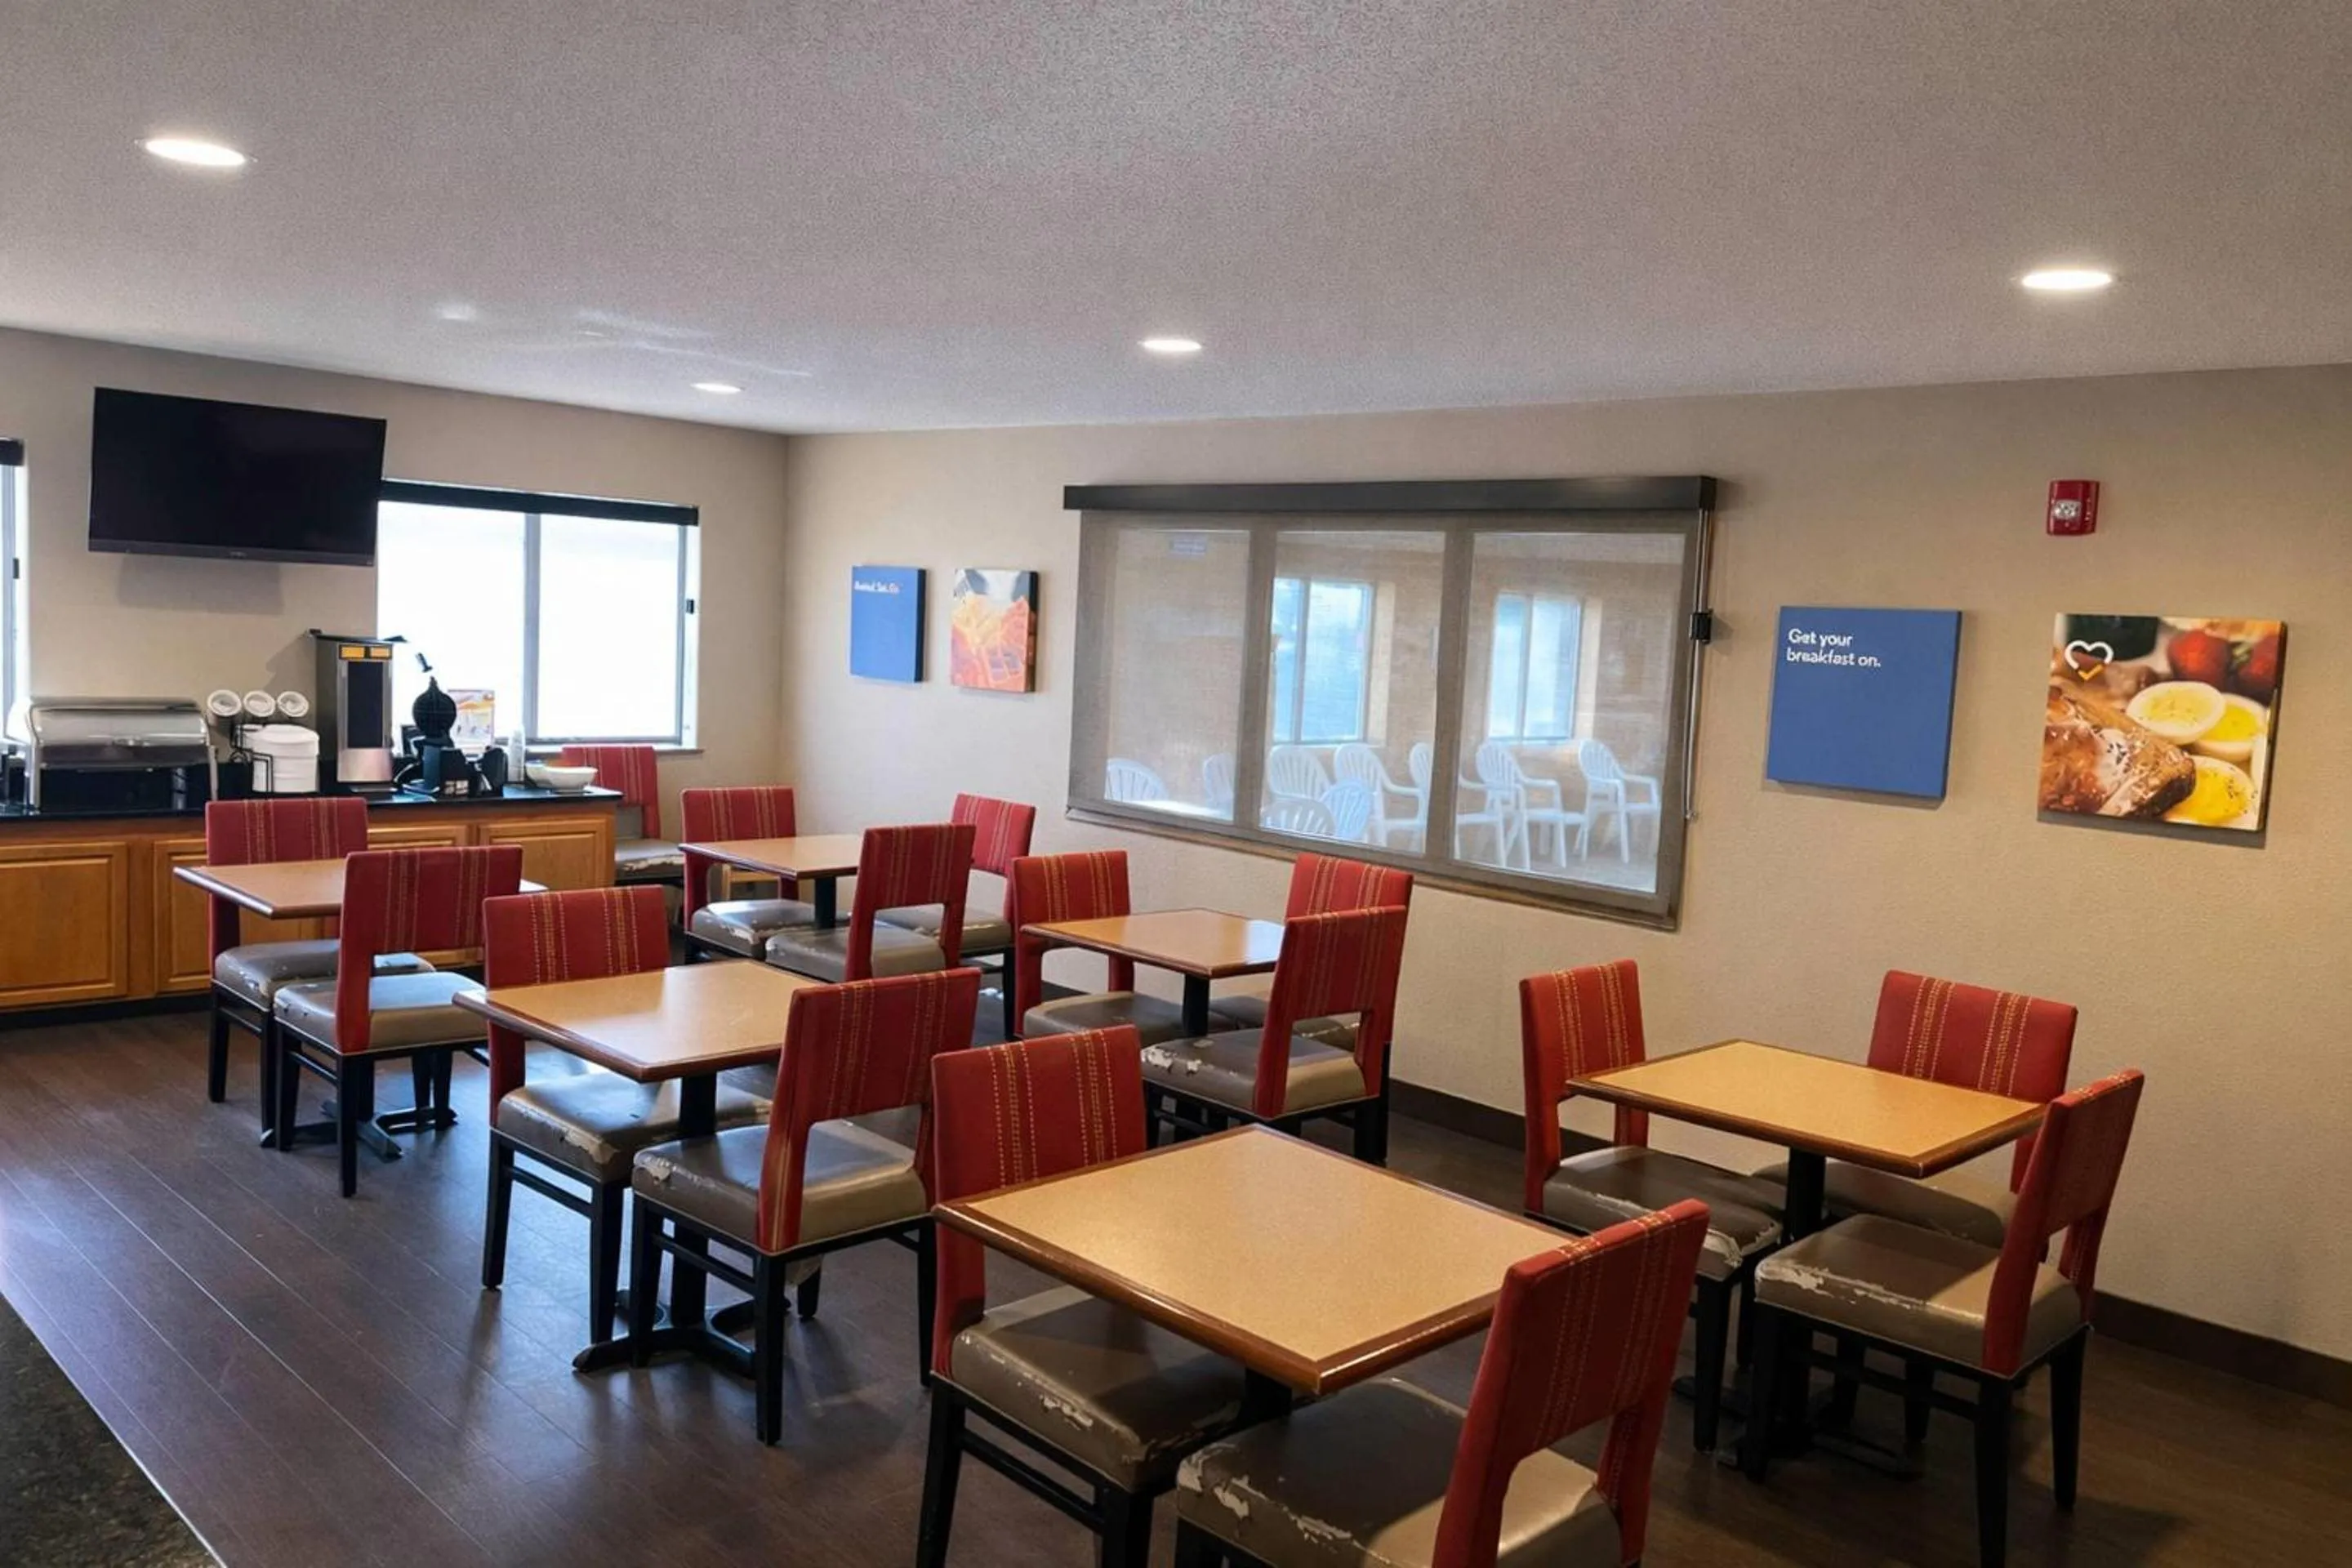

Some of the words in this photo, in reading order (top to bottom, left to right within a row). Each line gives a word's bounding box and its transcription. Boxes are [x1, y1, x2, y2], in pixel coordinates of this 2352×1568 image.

[1788, 628, 1817, 644] Get
[1820, 634, 1853, 648] your
[1786, 647, 1855, 666] breakfast
[1858, 656, 1882, 667] on.
